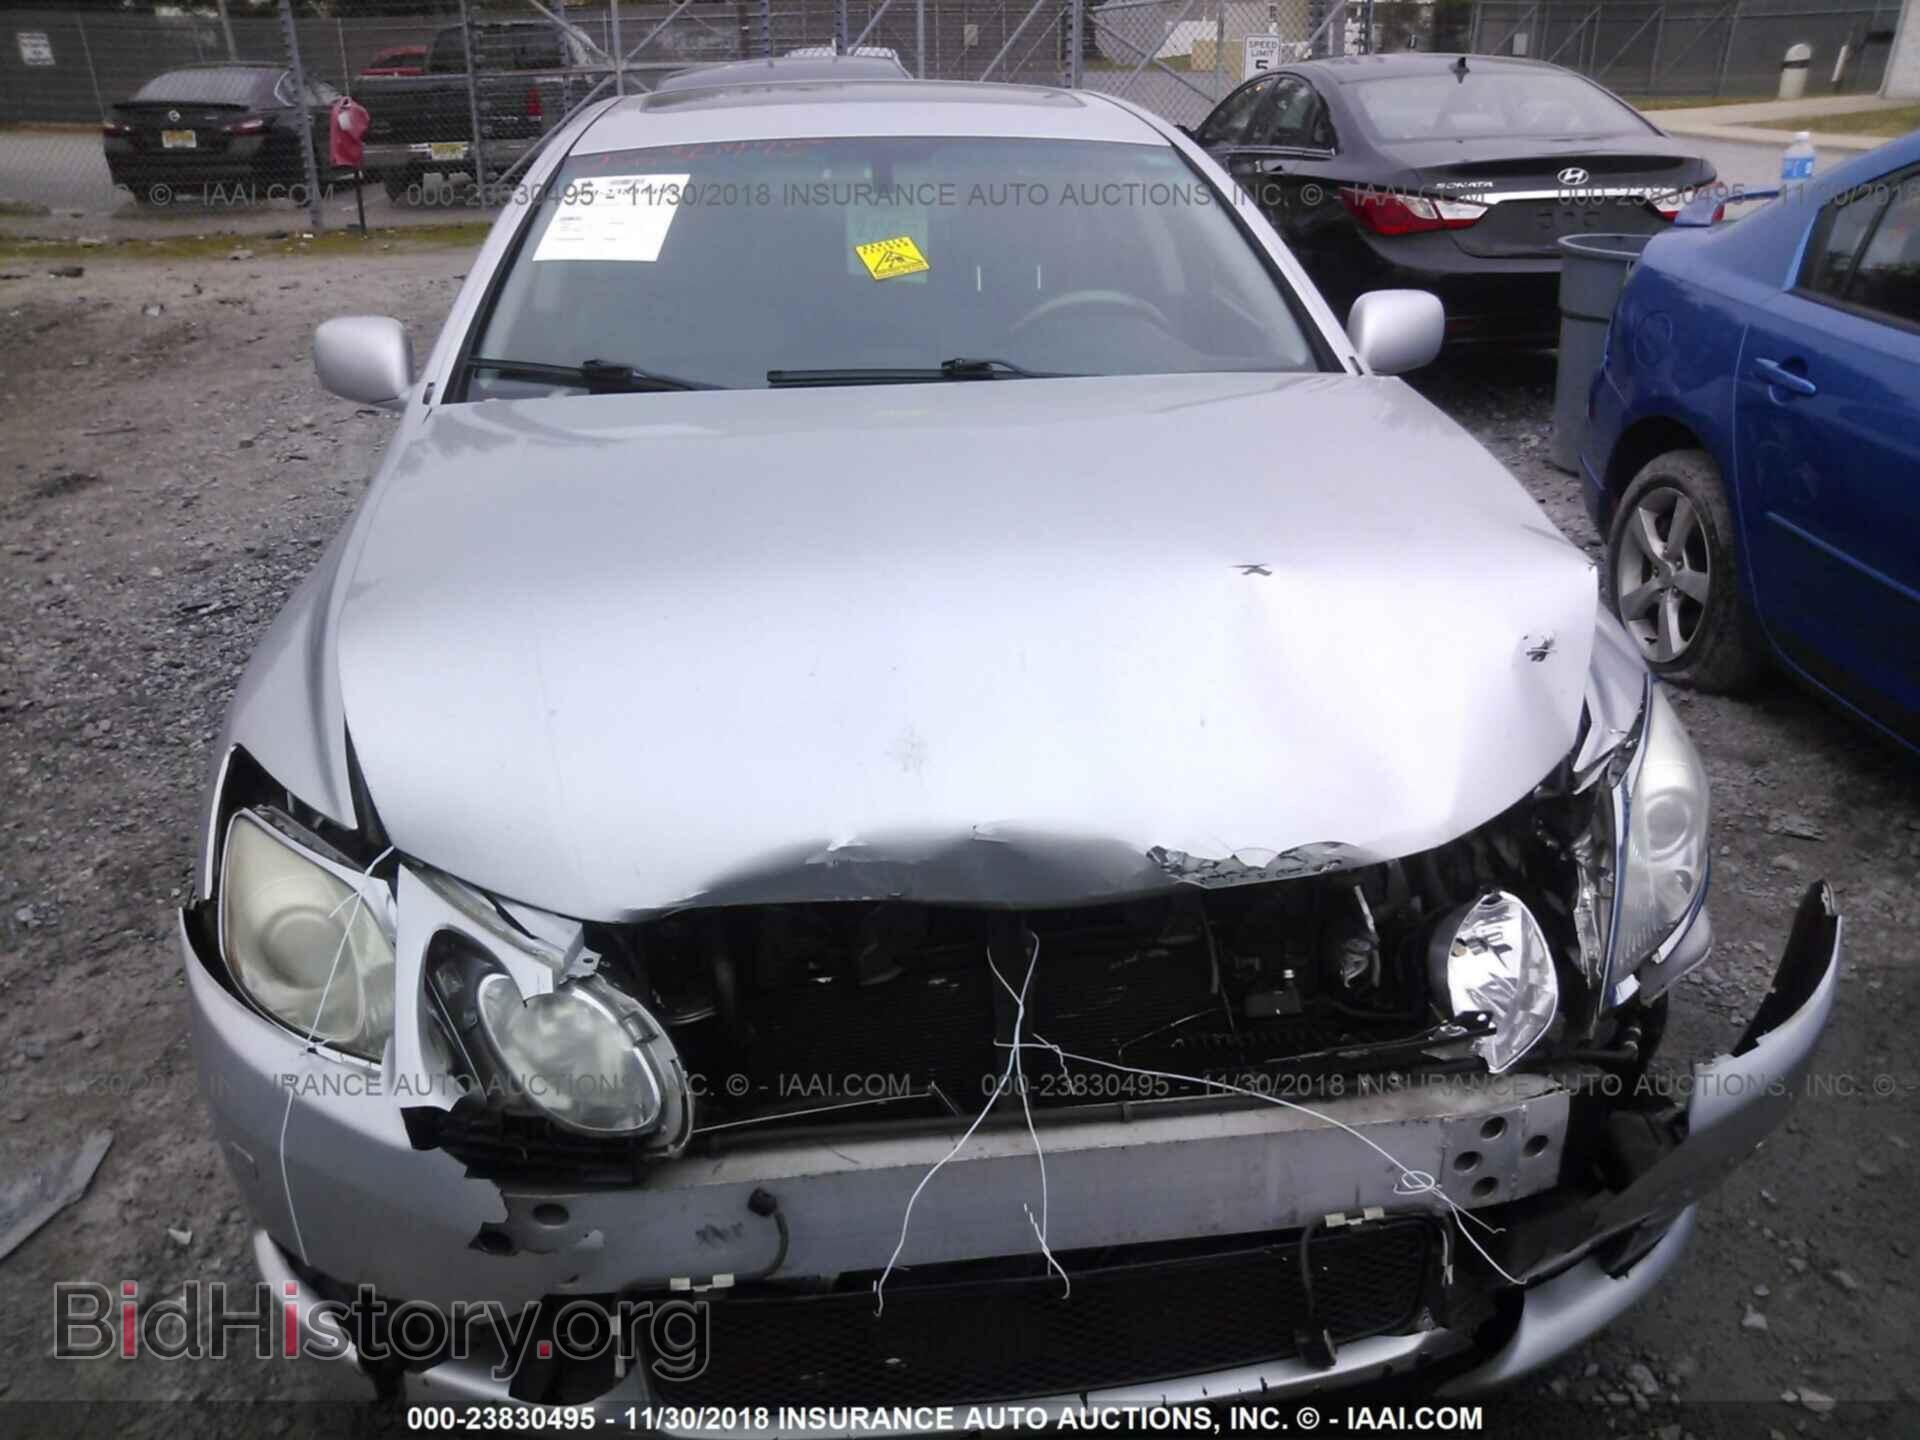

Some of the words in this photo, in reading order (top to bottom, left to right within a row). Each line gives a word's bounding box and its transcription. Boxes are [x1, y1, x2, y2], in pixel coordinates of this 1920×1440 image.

[1248, 40, 1278, 49] SPEED
[1250, 49, 1274, 57] LIMIT
[1435, 181, 1493, 190] SONATA
